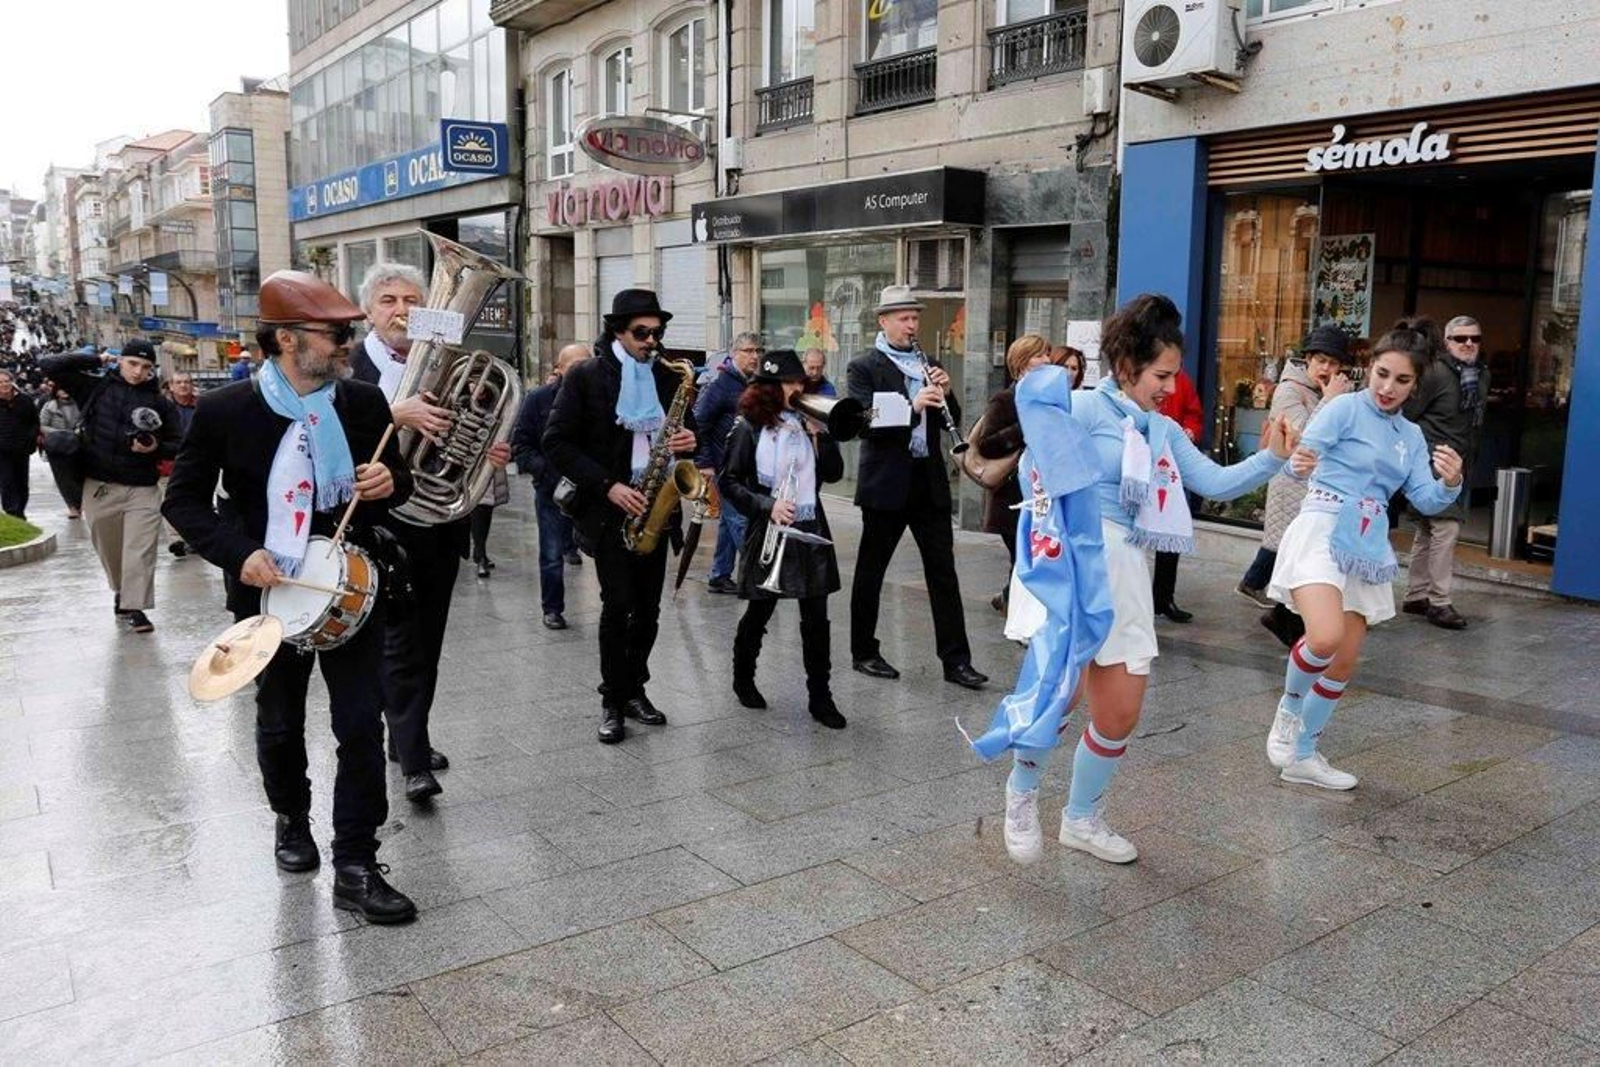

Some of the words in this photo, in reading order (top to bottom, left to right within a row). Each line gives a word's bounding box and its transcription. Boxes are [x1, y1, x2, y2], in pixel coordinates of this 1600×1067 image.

[453, 152, 492, 163] OCASO
[637, 136, 700, 161] novia
[1304, 121, 1450, 172] sémola
[324, 176, 359, 207] OCASO
[587, 175, 672, 221] novia
[864, 194, 877, 210] AS
[878, 192, 929, 210] Computer
